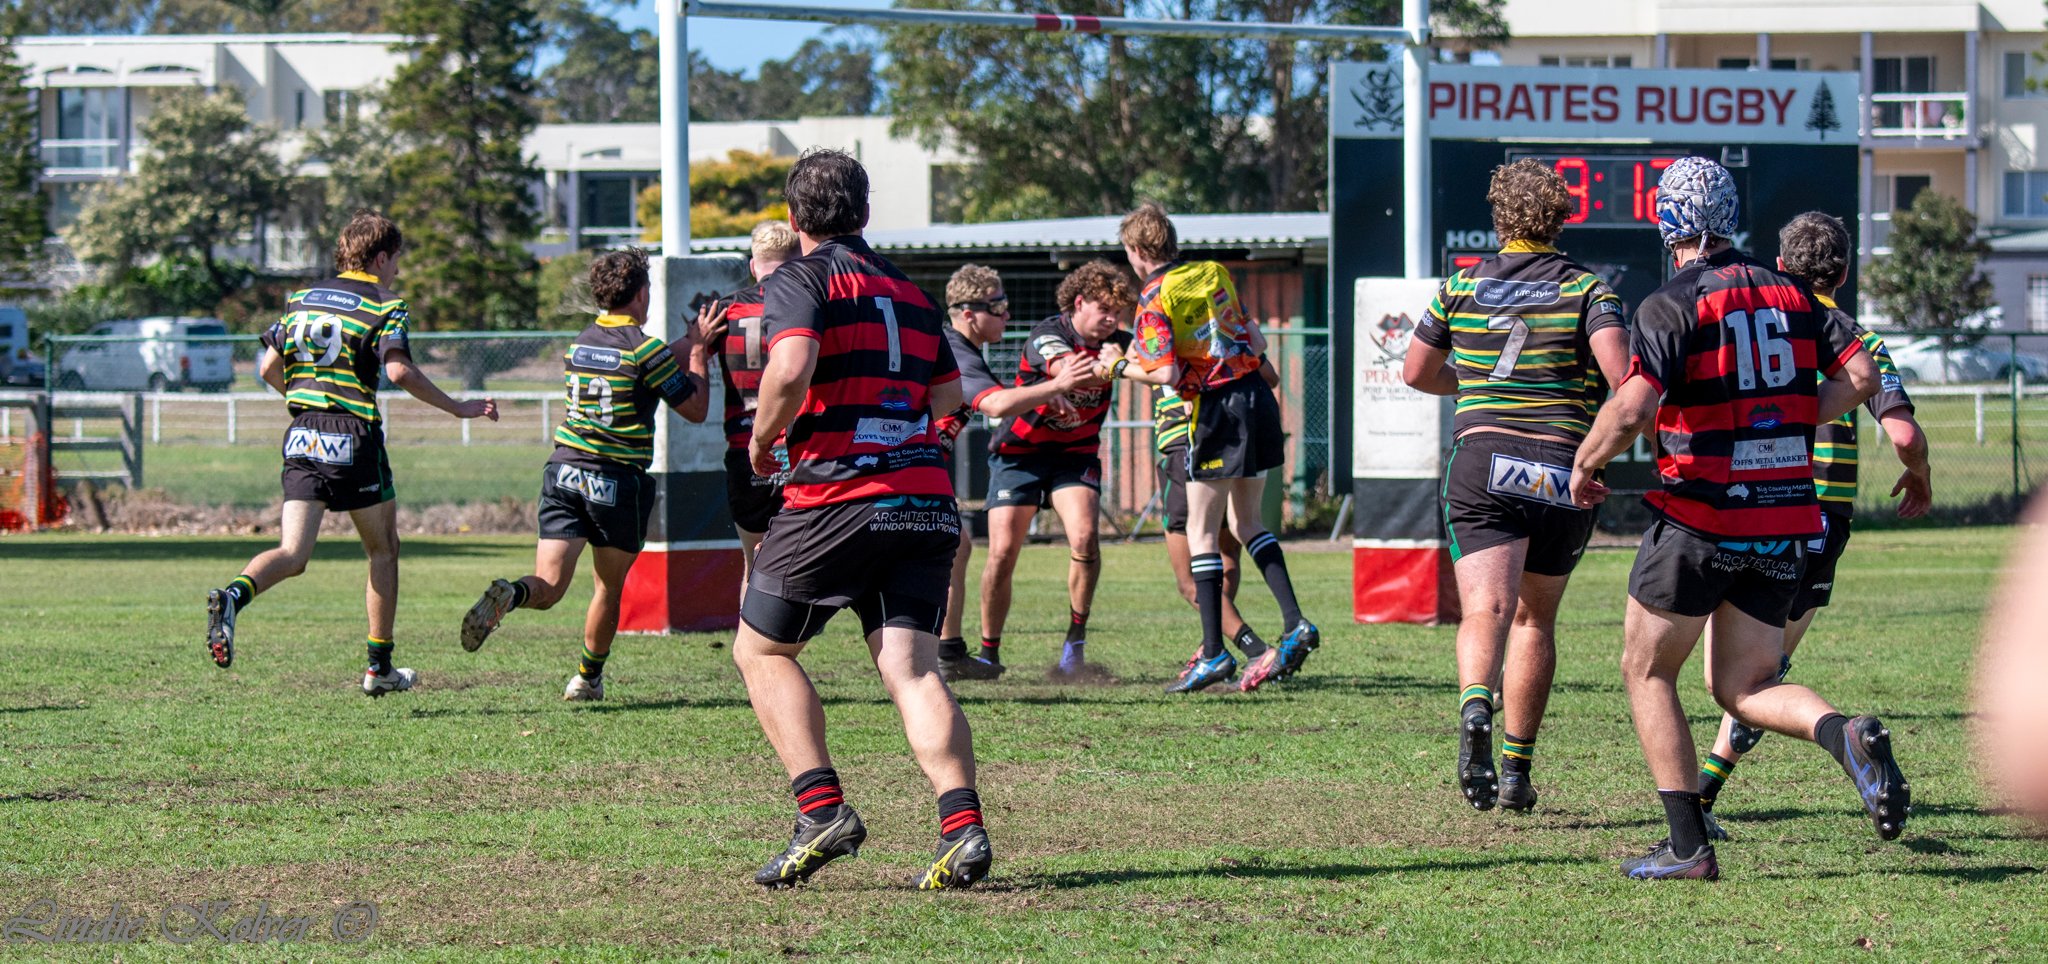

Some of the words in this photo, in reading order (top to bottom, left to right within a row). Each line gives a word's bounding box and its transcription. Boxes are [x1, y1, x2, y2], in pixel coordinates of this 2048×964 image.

[1428, 81, 1619, 123] PIRATES
[1636, 86, 1796, 126] RUGBY
[293, 310, 343, 367] 19
[873, 296, 902, 373] 1
[1487, 316, 1530, 382] 7
[1724, 307, 1797, 390] 16
[568, 373, 614, 428] 13
[871, 511, 959, 526] ARCHITECTURAL
